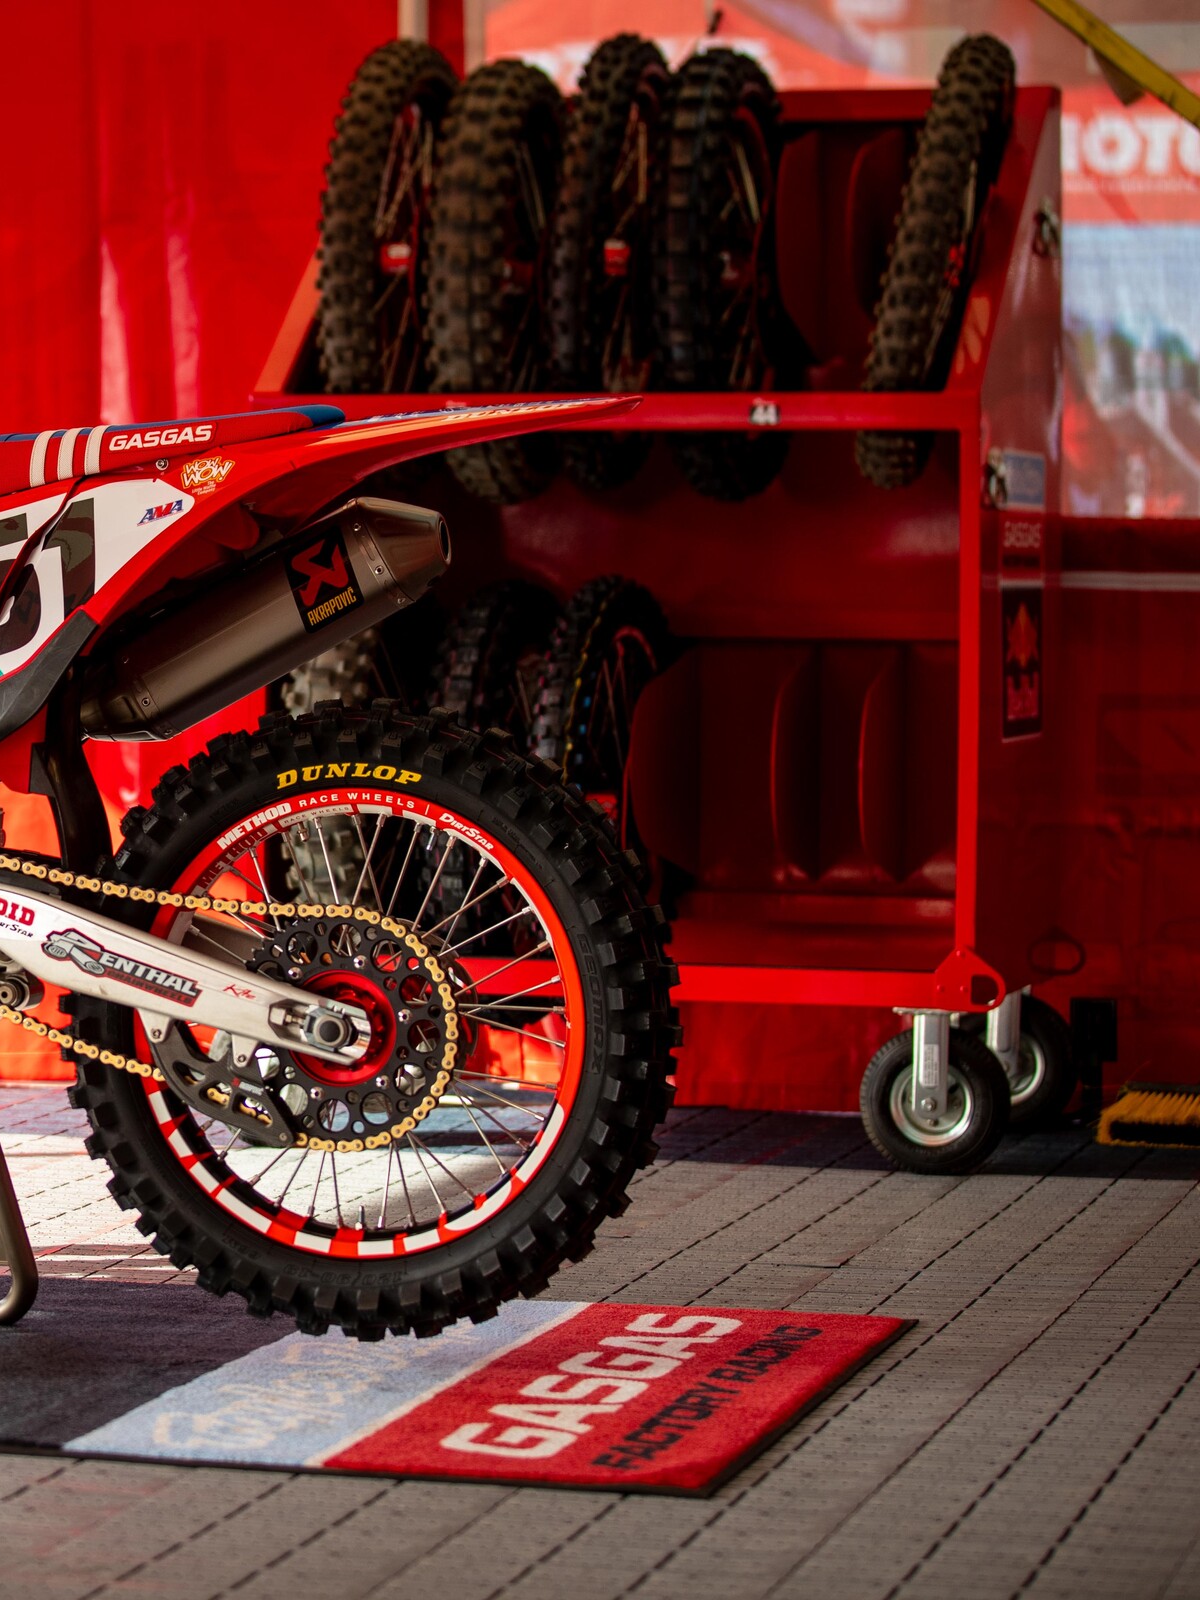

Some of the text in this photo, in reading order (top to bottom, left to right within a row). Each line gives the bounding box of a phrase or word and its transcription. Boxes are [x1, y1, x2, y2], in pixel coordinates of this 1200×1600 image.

[108, 424, 213, 452] GASGAS
[138, 499, 184, 525] AMA
[276, 762, 422, 790] DUNLOP
[216, 792, 416, 850] METHOD RACE WHEELS
[284, 807, 350, 824] RACE WHEELS
[439, 1312, 744, 1460] GASGAS
[591, 1323, 824, 1471] FACTORY RACING
